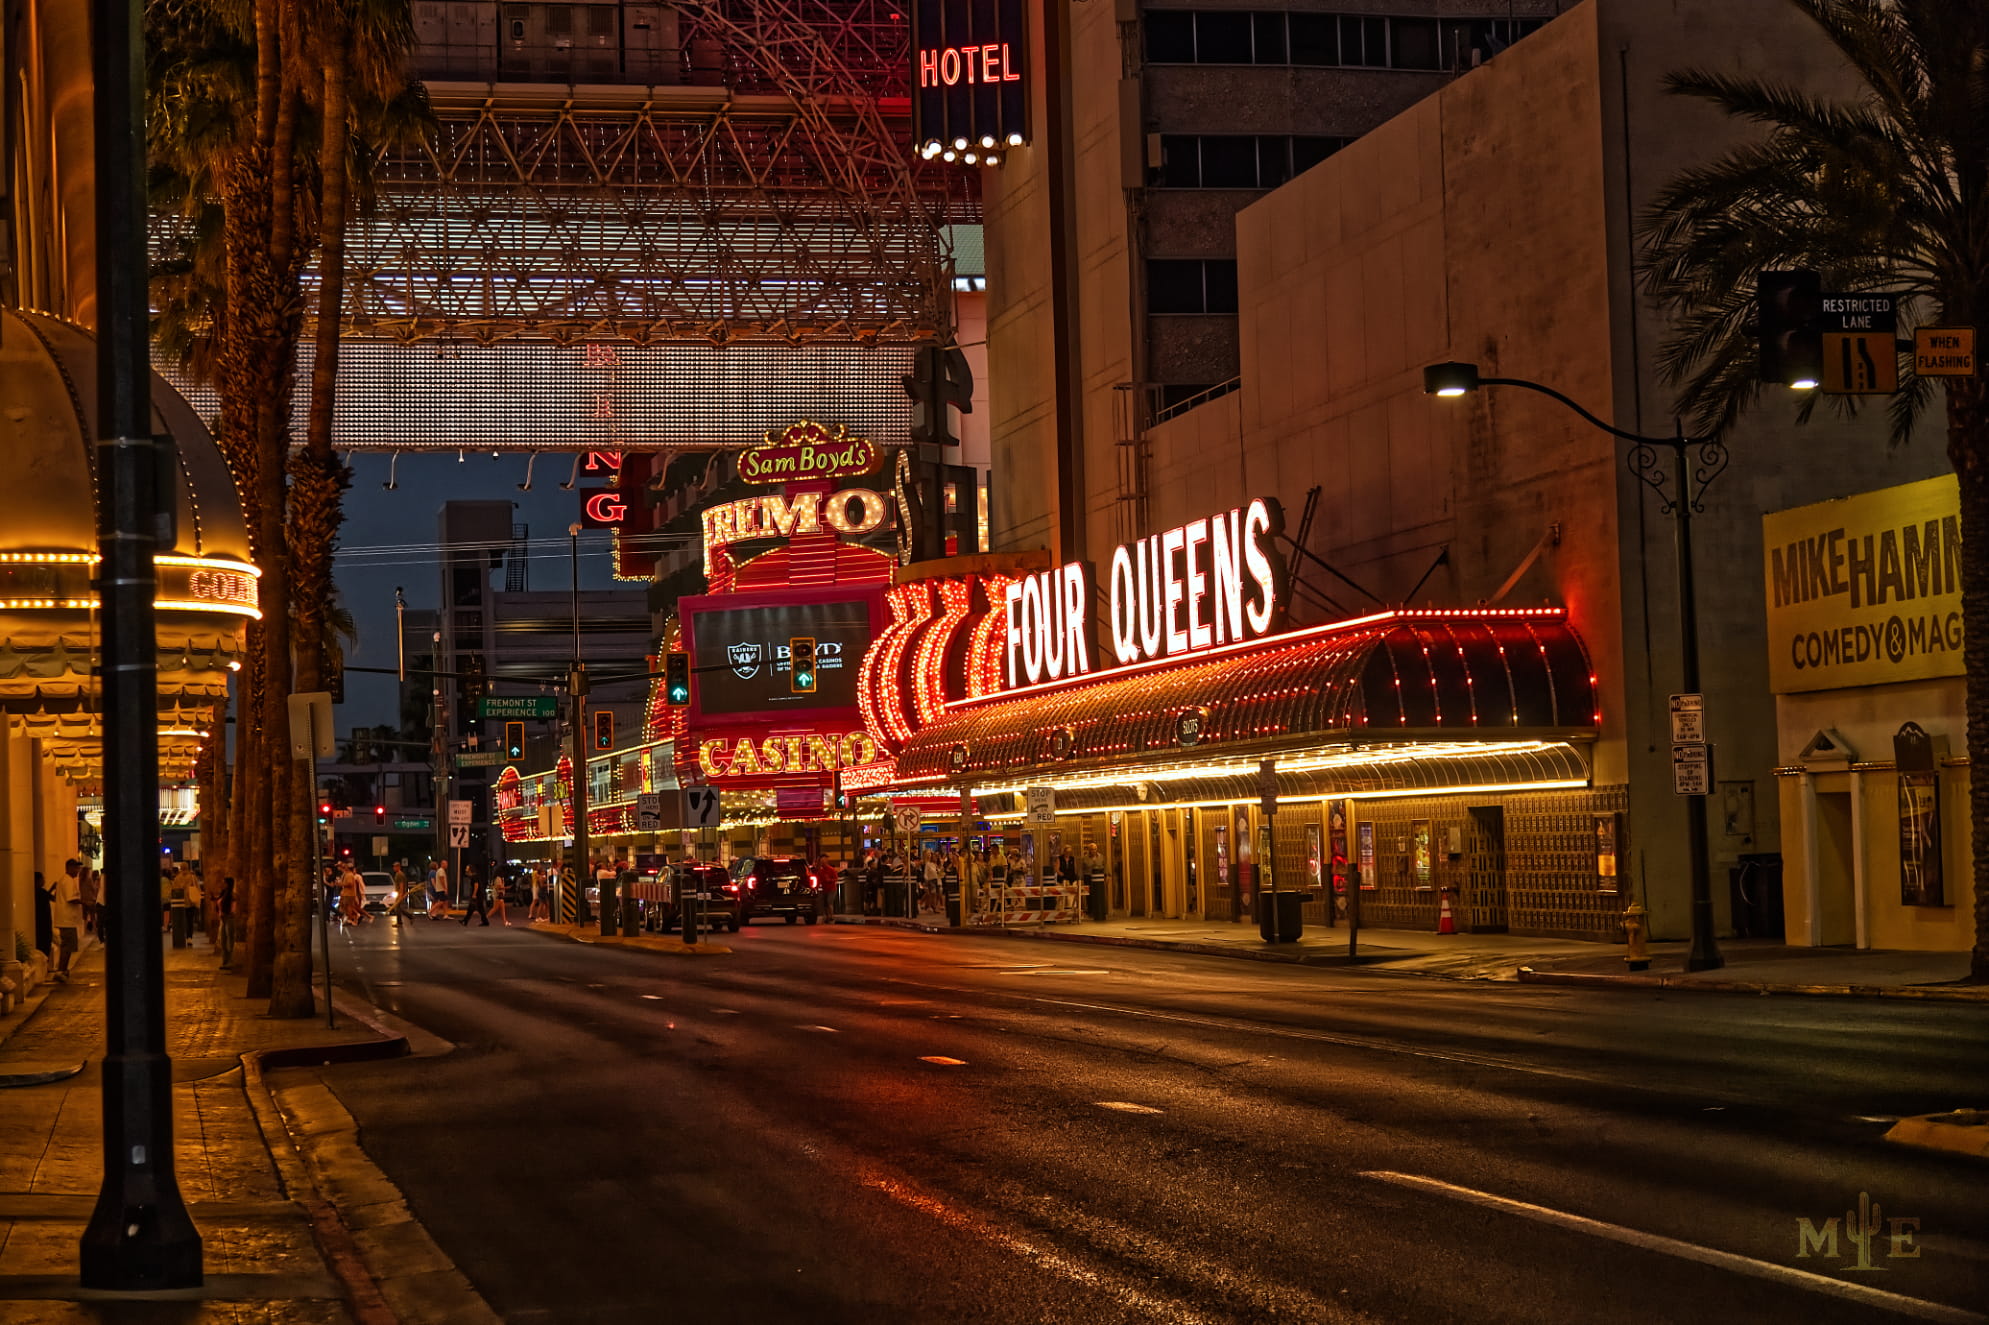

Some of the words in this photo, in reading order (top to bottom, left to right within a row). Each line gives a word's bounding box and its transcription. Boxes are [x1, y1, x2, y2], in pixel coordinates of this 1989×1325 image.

[920, 42, 1021, 88] HOTEL
[1822, 299, 1890, 313] RESTRICTED
[1842, 315, 1872, 329] LANE
[1929, 336, 1960, 349] WHEN
[1918, 356, 1971, 369] FLASHING
[745, 450, 796, 477] Sam
[799, 442, 867, 474] Boyd's
[701, 487, 898, 578] FREMO
[1771, 527, 1849, 609] MIKE
[1004, 560, 1090, 689] FOUR
[1109, 496, 1276, 666] QUEENS
[1791, 622, 1884, 670] COMEDY
[486, 699, 525, 707] FREMONT
[527, 699, 537, 707] ST
[486, 708, 537, 717] EXPERIENCE
[699, 731, 878, 778] CASINO
[1031, 790, 1051, 798] STOP
[1037, 813, 1052, 821] RED
[641, 820, 659, 829] RED
